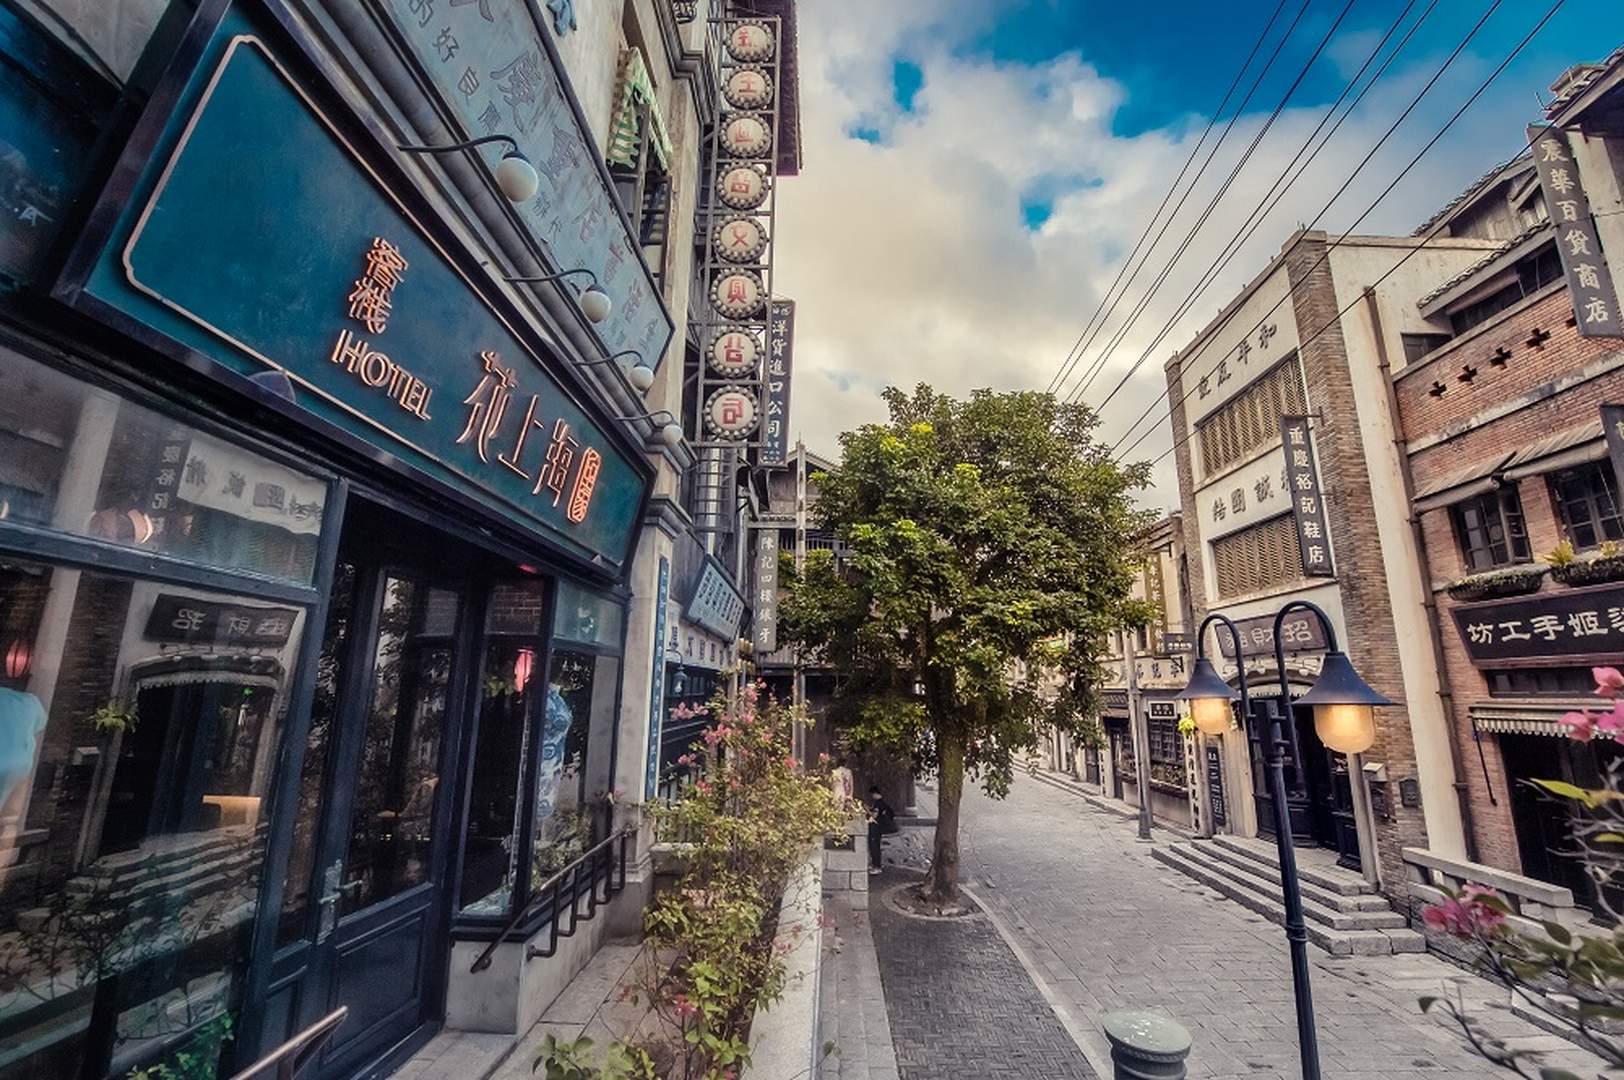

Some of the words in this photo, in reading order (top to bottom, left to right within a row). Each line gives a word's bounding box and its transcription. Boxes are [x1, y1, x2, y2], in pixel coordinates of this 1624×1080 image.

[331, 329, 432, 421] HOTEL
[767, 319, 788, 438] 洋貨進口公司
[1288, 426, 1324, 563] 重慶裕記鞋店
